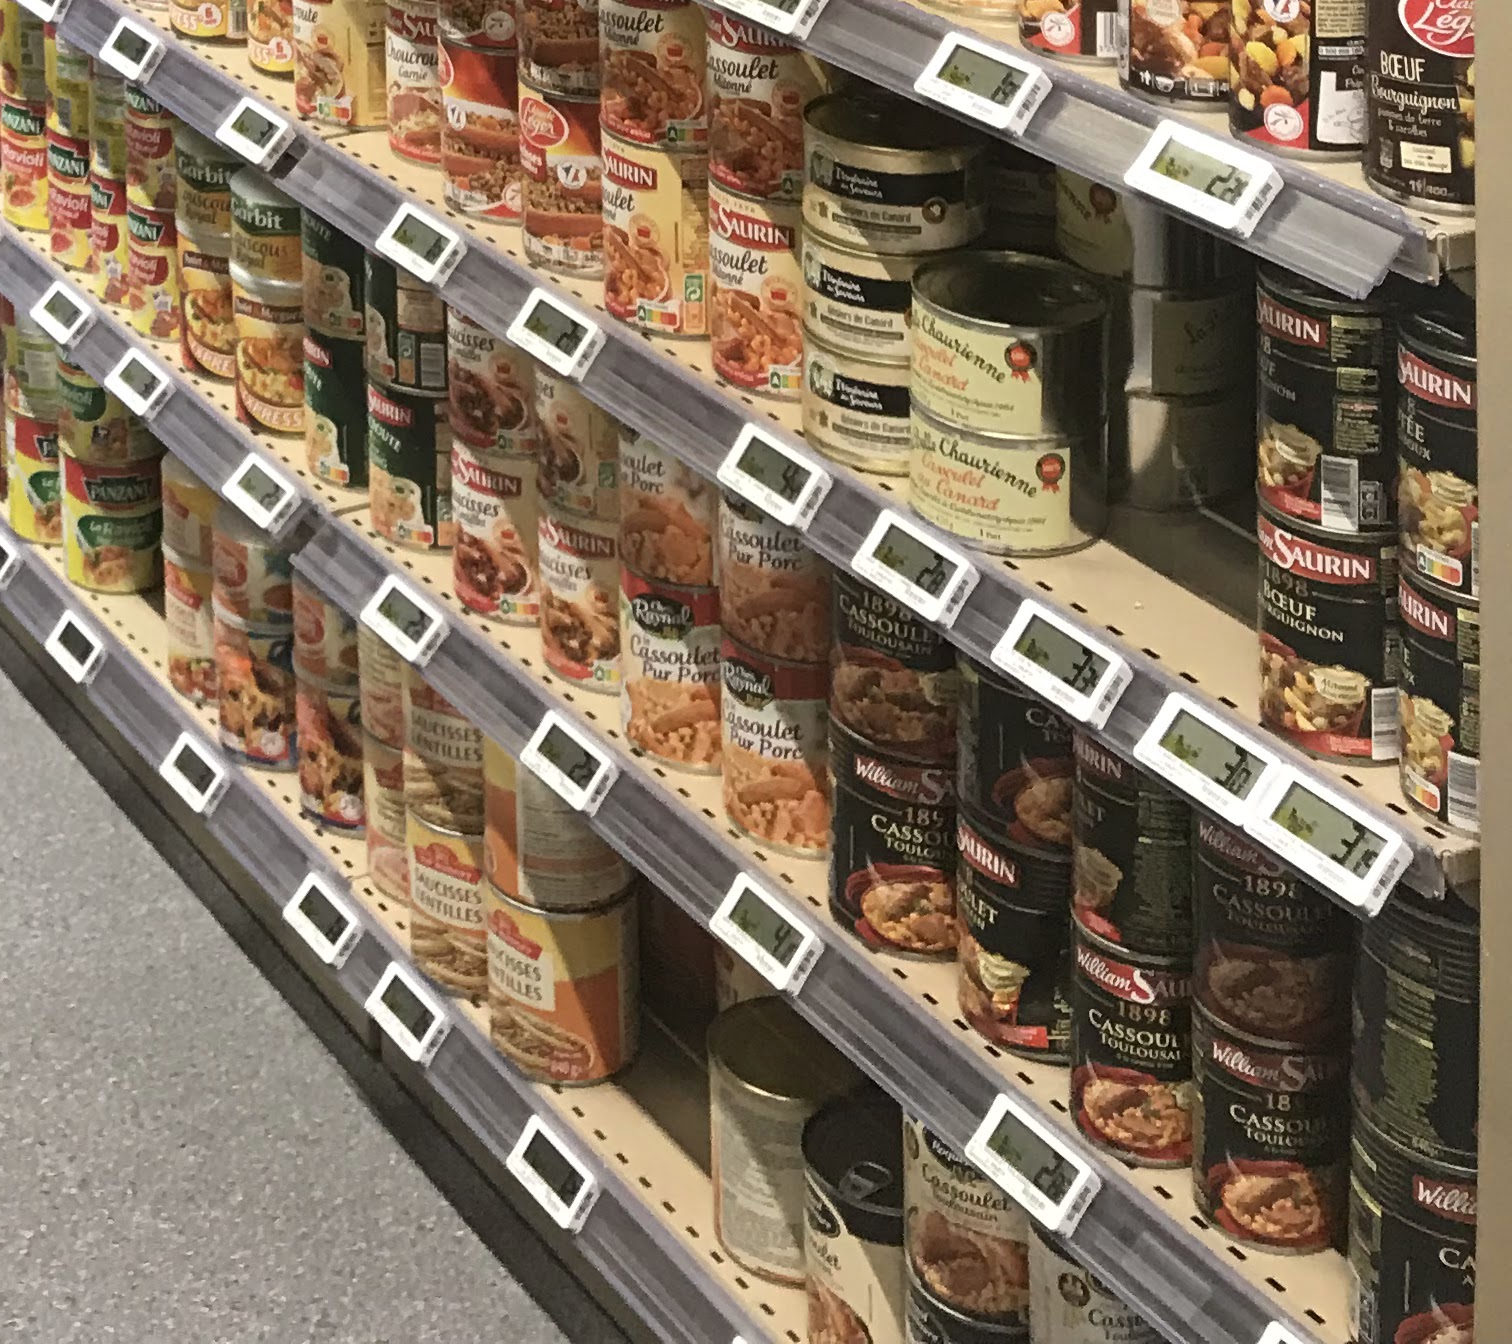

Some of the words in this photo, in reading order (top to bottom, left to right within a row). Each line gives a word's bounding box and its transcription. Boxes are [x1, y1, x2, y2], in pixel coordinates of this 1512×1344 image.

[1380, 49, 1426, 83] BŒUF
[1370, 73, 1458, 113] Bourguignon
[230, 198, 283, 230] Garbit
[716, 203, 791, 245] SAURIN
[920, 315, 1007, 384] Chaurienne
[938, 436, 1038, 499] Chaurienne
[935, 478, 1001, 512] Canard
[728, 548, 752, 568] Pur
[757, 550, 803, 572] Porc
[1273, 529, 1371, 581] SAURIN
[1262, 579, 1317, 621] BŒUF
[629, 634, 721, 665] Cassoulet
[641, 659, 674, 682] Pur
[677, 664, 721, 685] Porc
[729, 729, 755, 751] Pur
[759, 736, 804, 761] Porc
[856, 757, 919, 793] William
[1199, 821, 1259, 866] William
[1076, 945, 1132, 993] William
[921, 1162, 1012, 1211] Cassoulet
